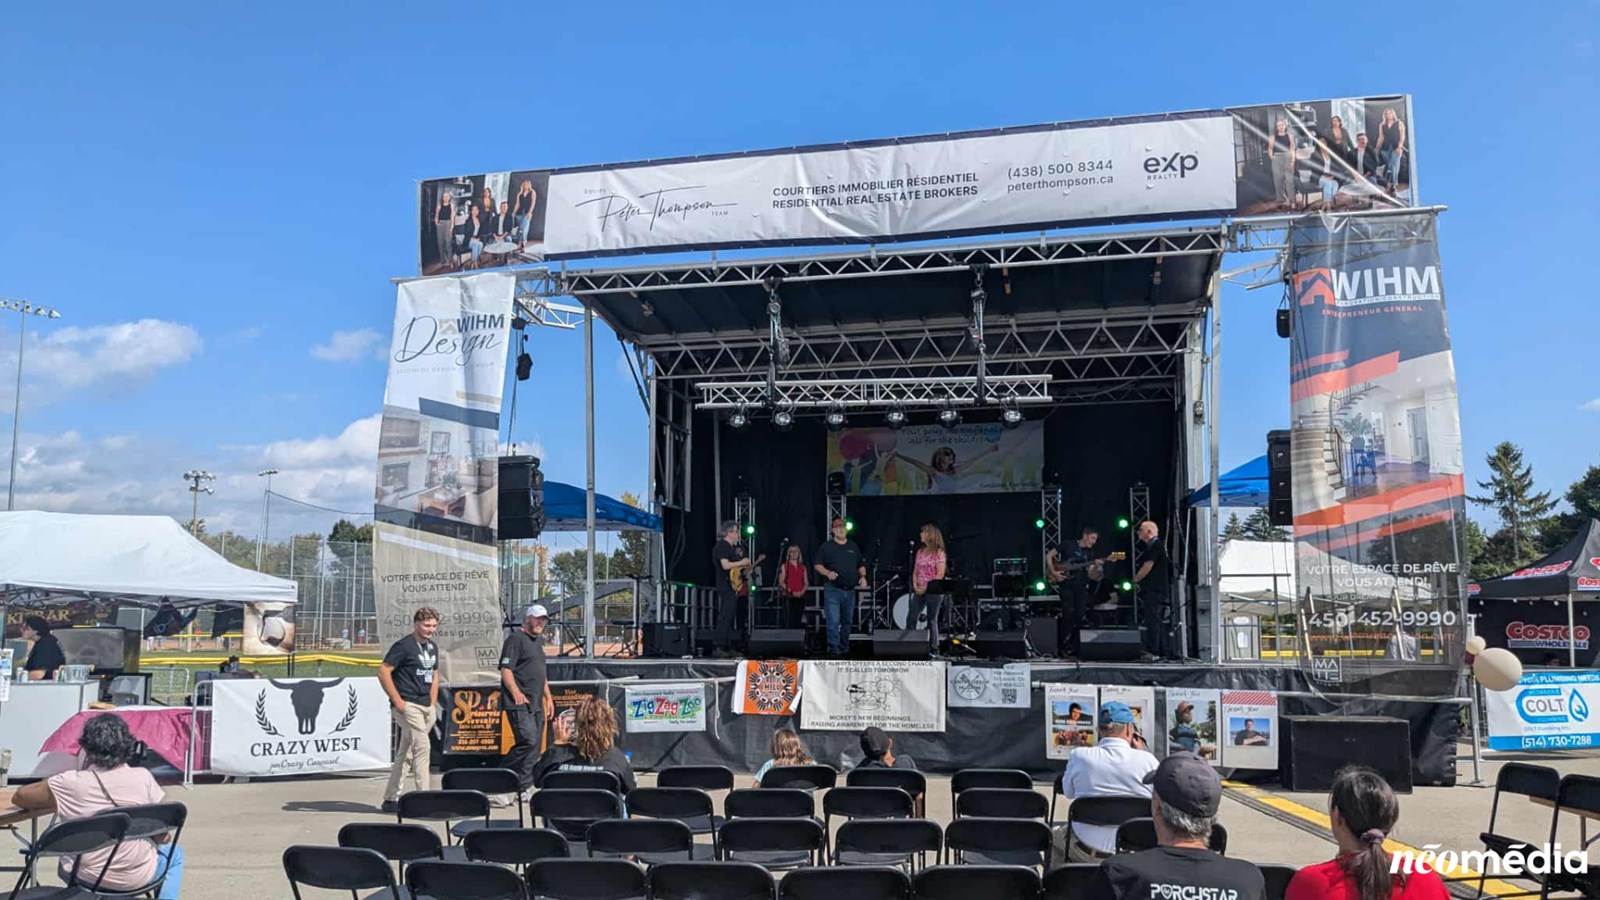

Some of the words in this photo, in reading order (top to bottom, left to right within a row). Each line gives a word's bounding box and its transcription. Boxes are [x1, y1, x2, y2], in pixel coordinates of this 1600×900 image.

[1007, 165, 1043, 180] (438)
[1048, 162, 1074, 175] 500
[1077, 159, 1114, 172] 8344
[1147, 173, 1179, 181] REALTY
[773, 184, 836, 197] COURTIERS
[838, 178, 904, 193] IMMOBILIER
[906, 172, 980, 188] RÉSIDENTIEL
[1007, 174, 1114, 194] peterthompson.ca
[772, 196, 844, 209] RESIDENTIAL
[846, 195, 875, 206] REAL
[877, 190, 922, 203] ESTATE
[924, 185, 978, 199] BROKERS
[638, 186, 738, 231] Thompson
[1331, 265, 1440, 300] WIHM
[457, 314, 504, 333] WIHM
[394, 316, 502, 366] Design
[381, 574, 410, 583] VOTRE
[412, 572, 447, 581] ESPACE
[449, 572, 462, 580] DE
[1306, 565, 1348, 575] VOTRE
[1351, 563, 1400, 574] ESPACE
[1403, 563, 1420, 574] DE
[1423, 561, 1457, 573] RÊVE
[402, 584, 427, 593] VOUS
[429, 582, 468, 591] ATTEND!
[1336, 577, 1372, 588] VOUS
[1506, 621, 1590, 640] COSTCO
[1540, 675, 1577, 683] PLUMBING
[1526, 699, 1564, 713] COLT
[250, 740, 309, 757] CRAZY
[313, 737, 362, 753] WEST
[1521, 737, 1546, 749] (514)
[1547, 736, 1592, 747] 730-7288
[306, 755, 340, 767] Carousel
